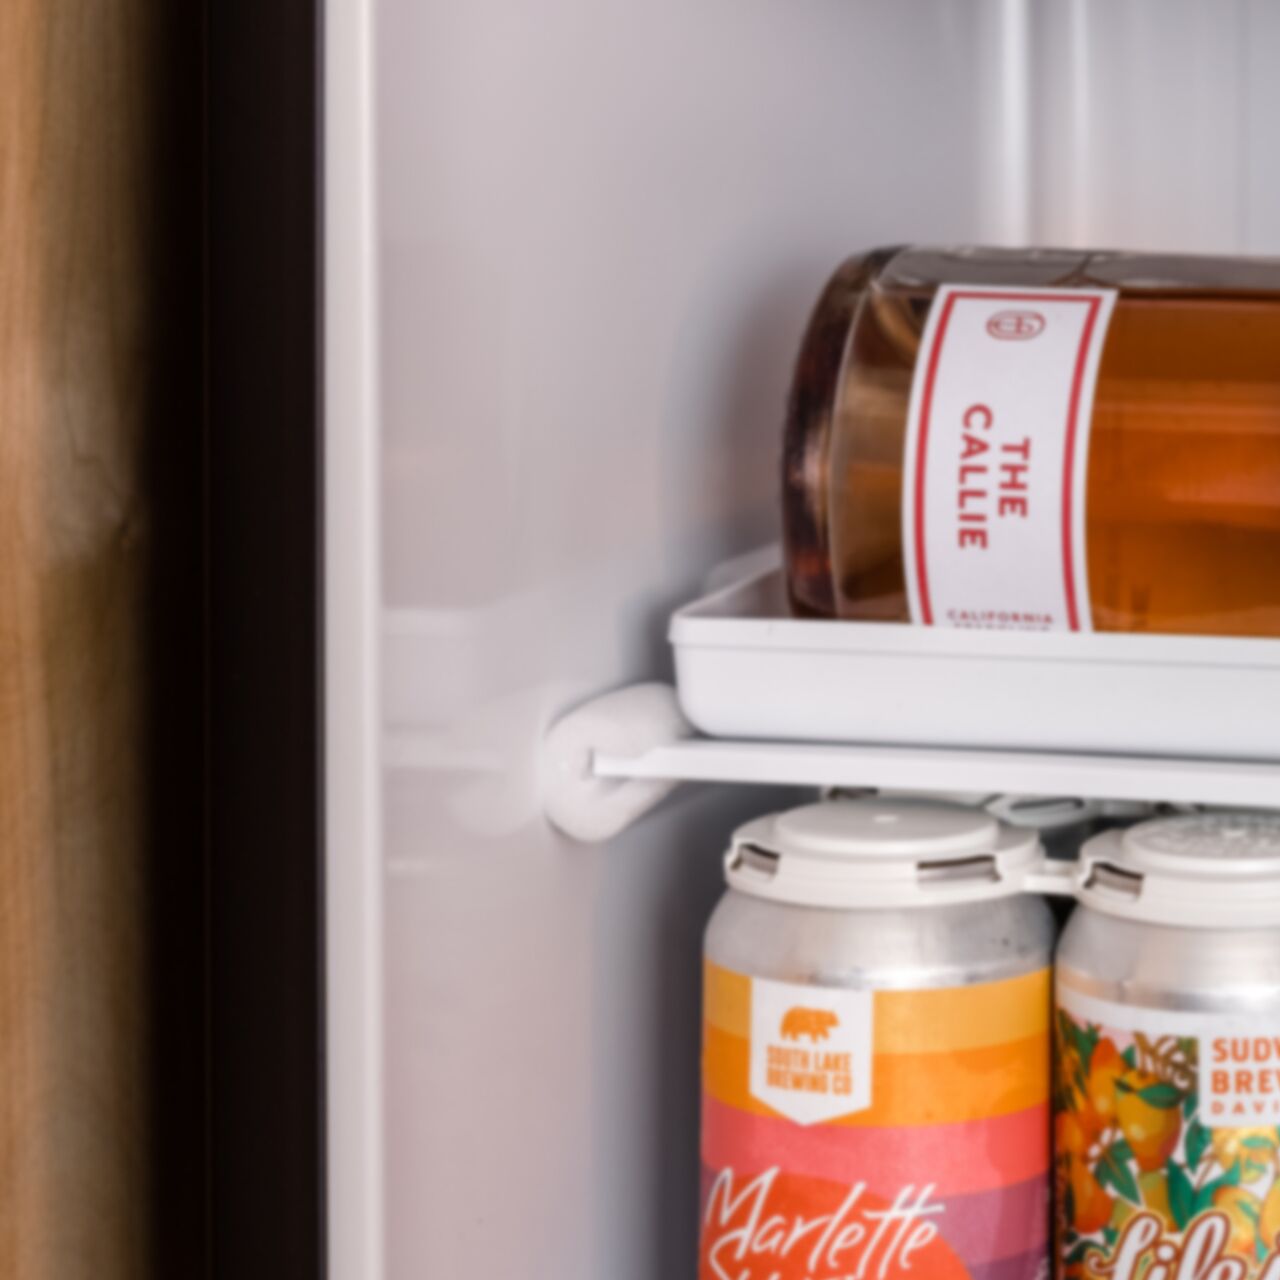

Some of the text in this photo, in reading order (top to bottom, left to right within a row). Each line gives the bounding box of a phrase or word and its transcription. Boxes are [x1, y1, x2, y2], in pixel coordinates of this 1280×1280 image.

[958, 404, 993, 550] CALLIE
[998, 437, 1031, 518] THE
[814, 1051, 852, 1073] LAKE
[705, 1165, 945, 1280] Marlette
